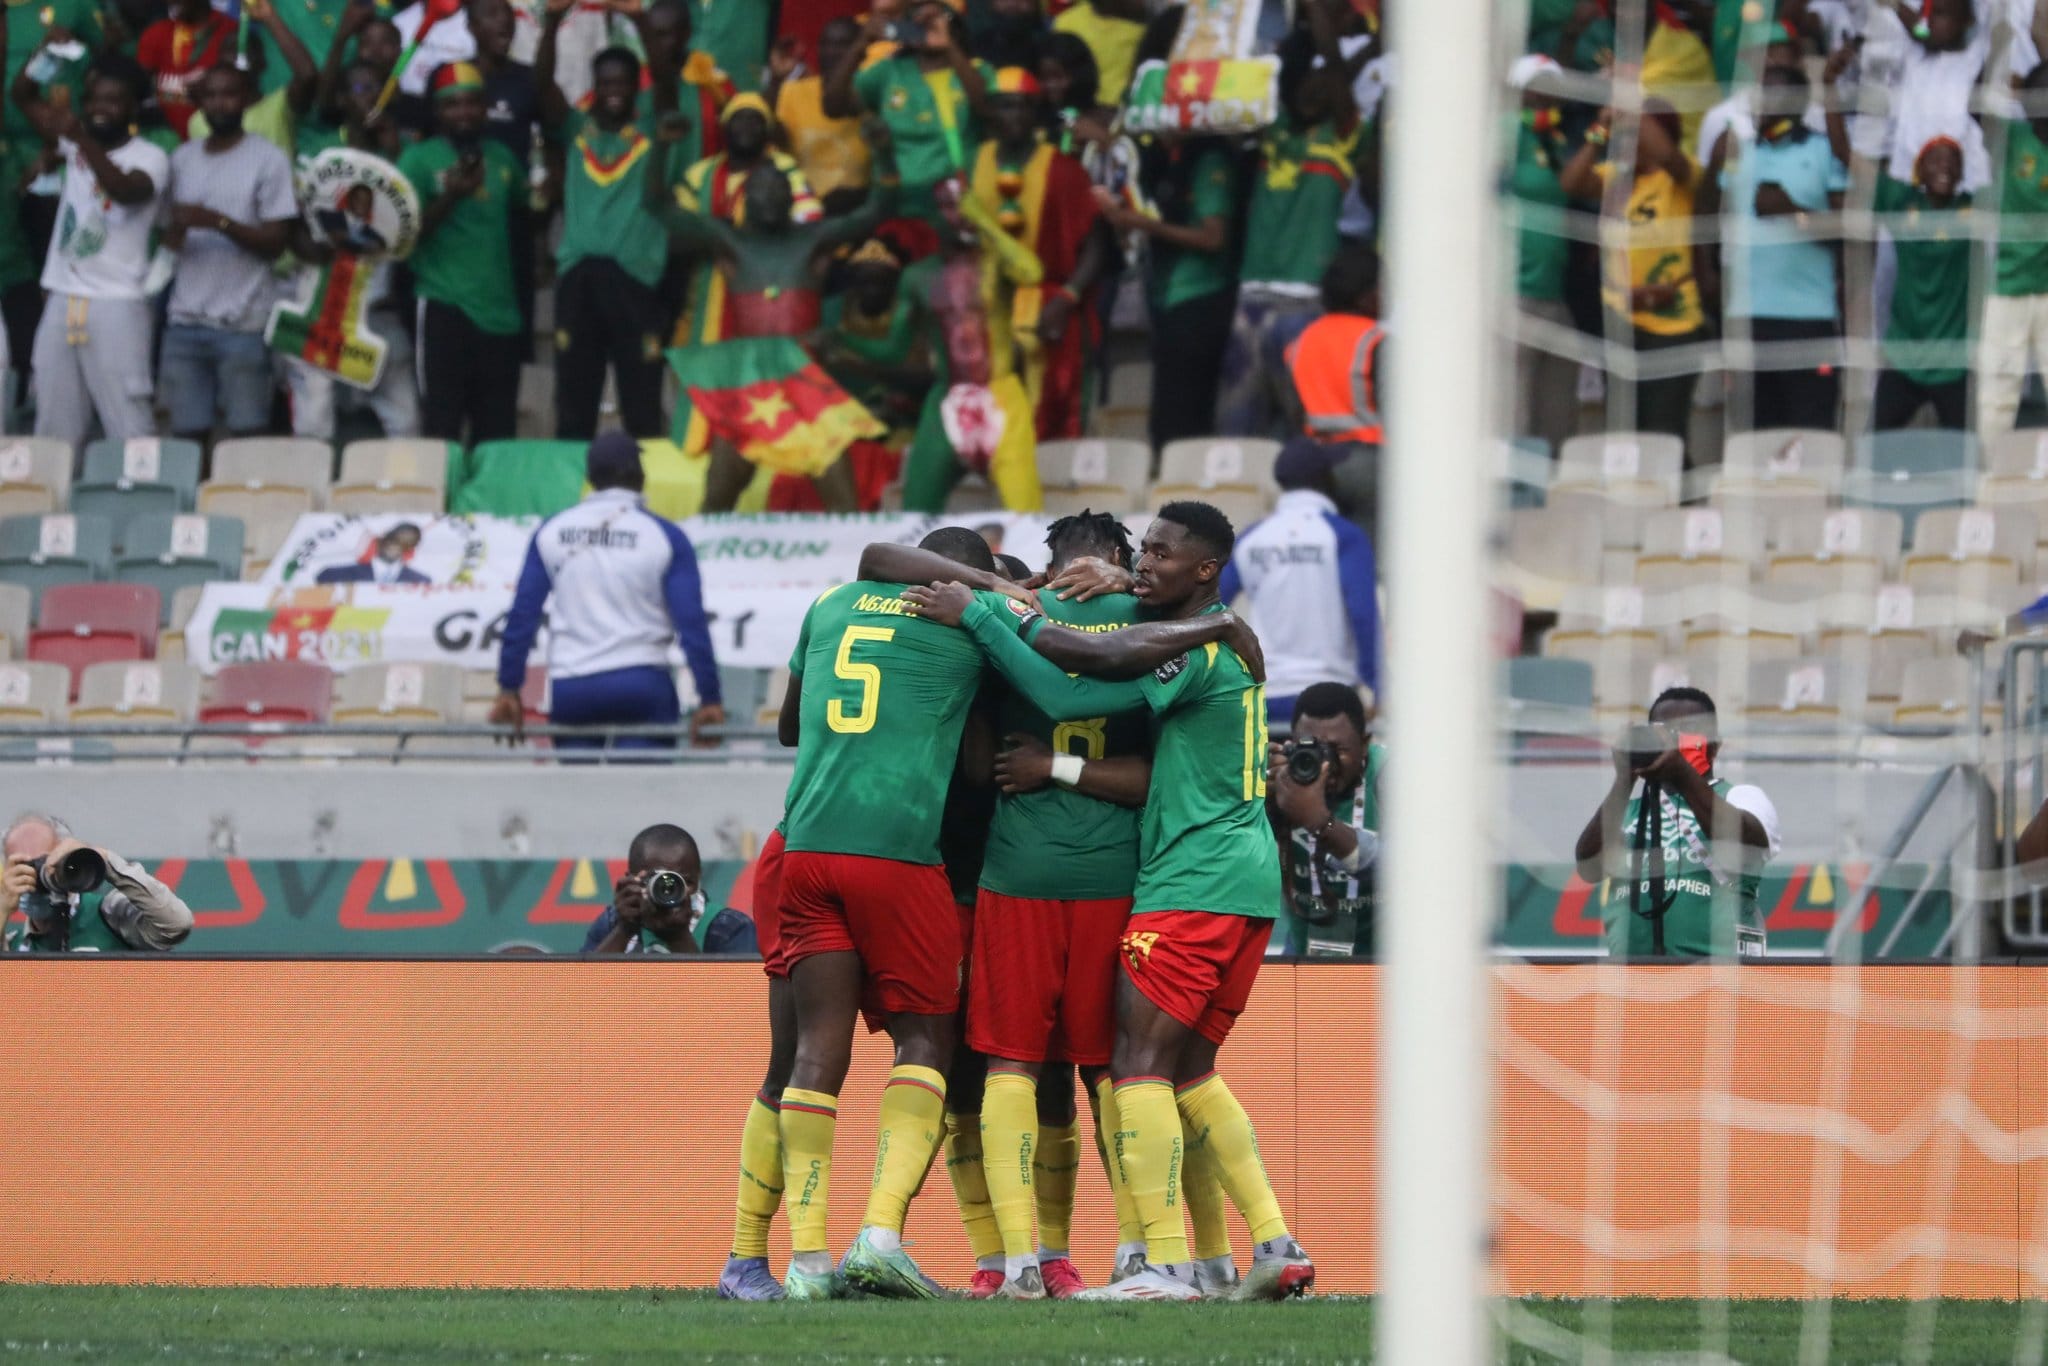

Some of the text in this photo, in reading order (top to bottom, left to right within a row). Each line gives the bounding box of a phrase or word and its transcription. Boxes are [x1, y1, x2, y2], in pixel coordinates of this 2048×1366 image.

[211, 631, 288, 660] CAN
[827, 625, 895, 733] 5
[1166, 1137, 1181, 1207] CAMEROUN
